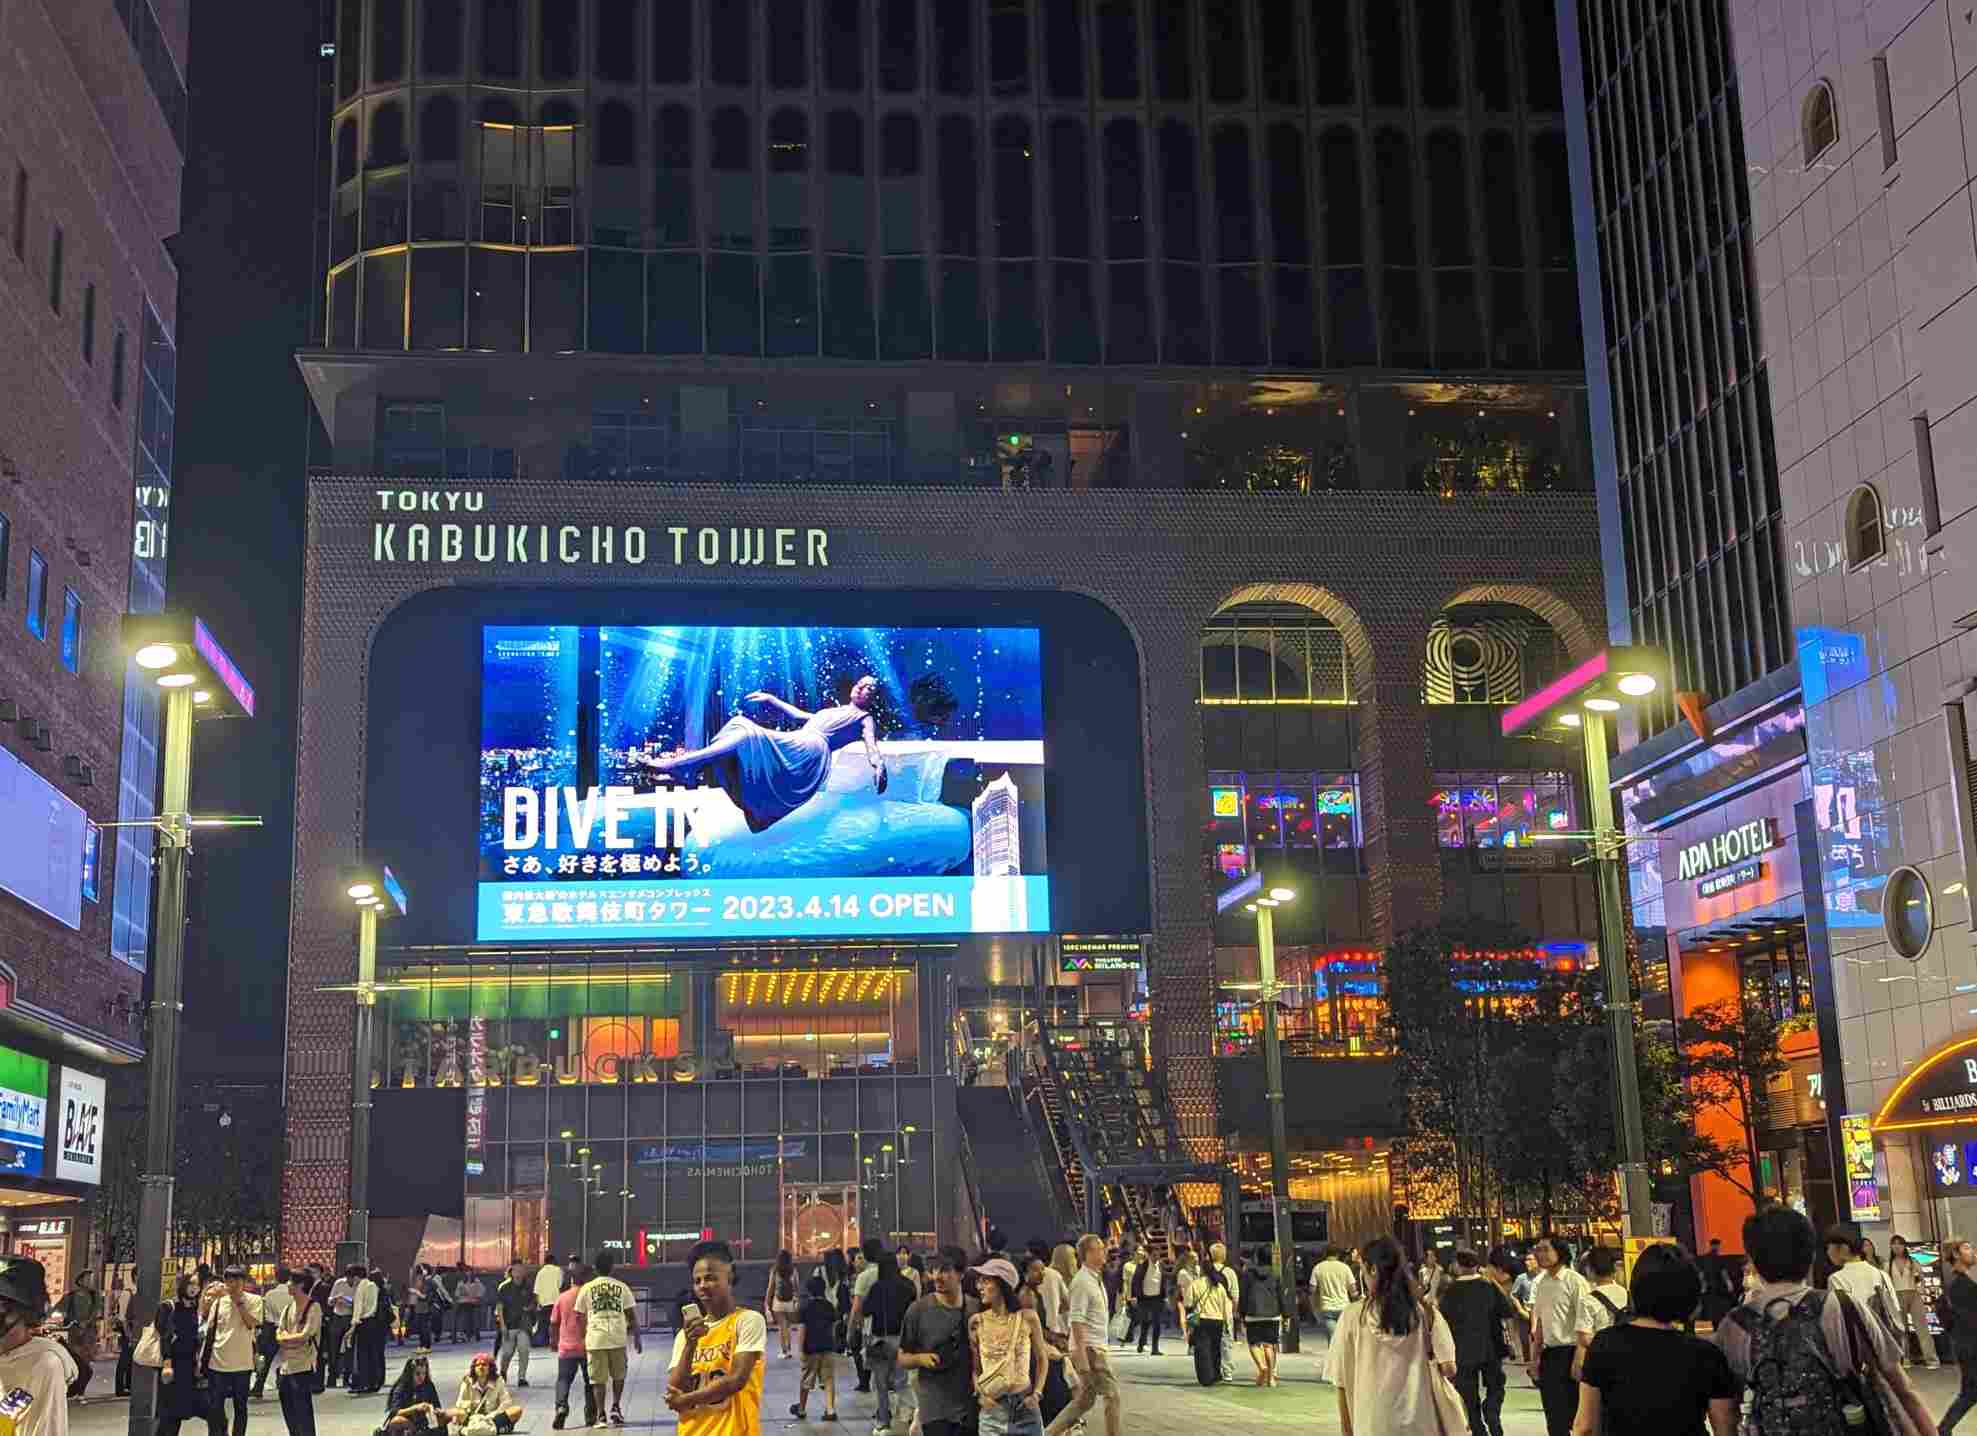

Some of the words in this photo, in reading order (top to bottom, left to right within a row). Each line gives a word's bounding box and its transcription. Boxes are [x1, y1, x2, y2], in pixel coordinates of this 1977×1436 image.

[376, 490, 484, 512] TOKYU
[374, 523, 646, 564] KABUKICHO
[667, 527, 829, 567] TOWER
[503, 786, 634, 850] DIVE
[655, 785, 709, 848] IN
[503, 853, 712, 875] さあ、好きを極めよう。
[1679, 841, 1712, 880] APA
[1712, 818, 1773, 867] HOTEL
[722, 895, 861, 920] 2023.4.14
[869, 893, 955, 918] OPEN
[0, 1095, 40, 1128] amilyMart
[1932, 1092, 1977, 1111] BILLIARDS
